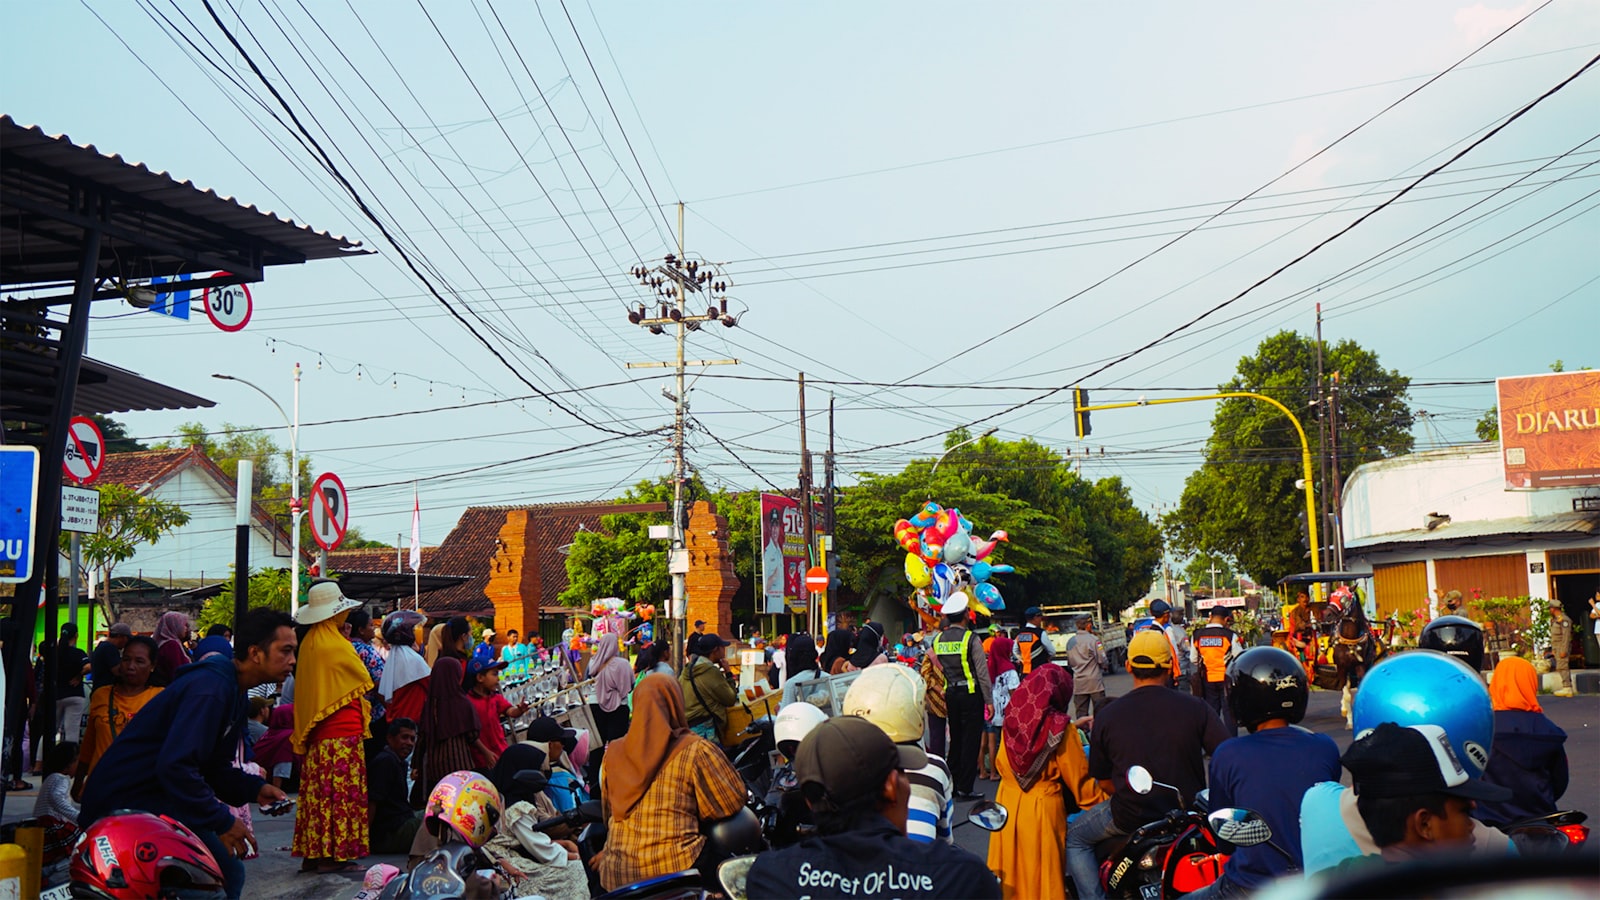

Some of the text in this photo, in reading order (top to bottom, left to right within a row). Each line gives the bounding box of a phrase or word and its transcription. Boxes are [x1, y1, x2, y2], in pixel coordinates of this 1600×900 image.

[211, 286, 244, 315] 30 km
[322, 487, 339, 536] P
[798, 862, 934, 895] Secret Of Love
[1109, 857, 1133, 889] HONDA
